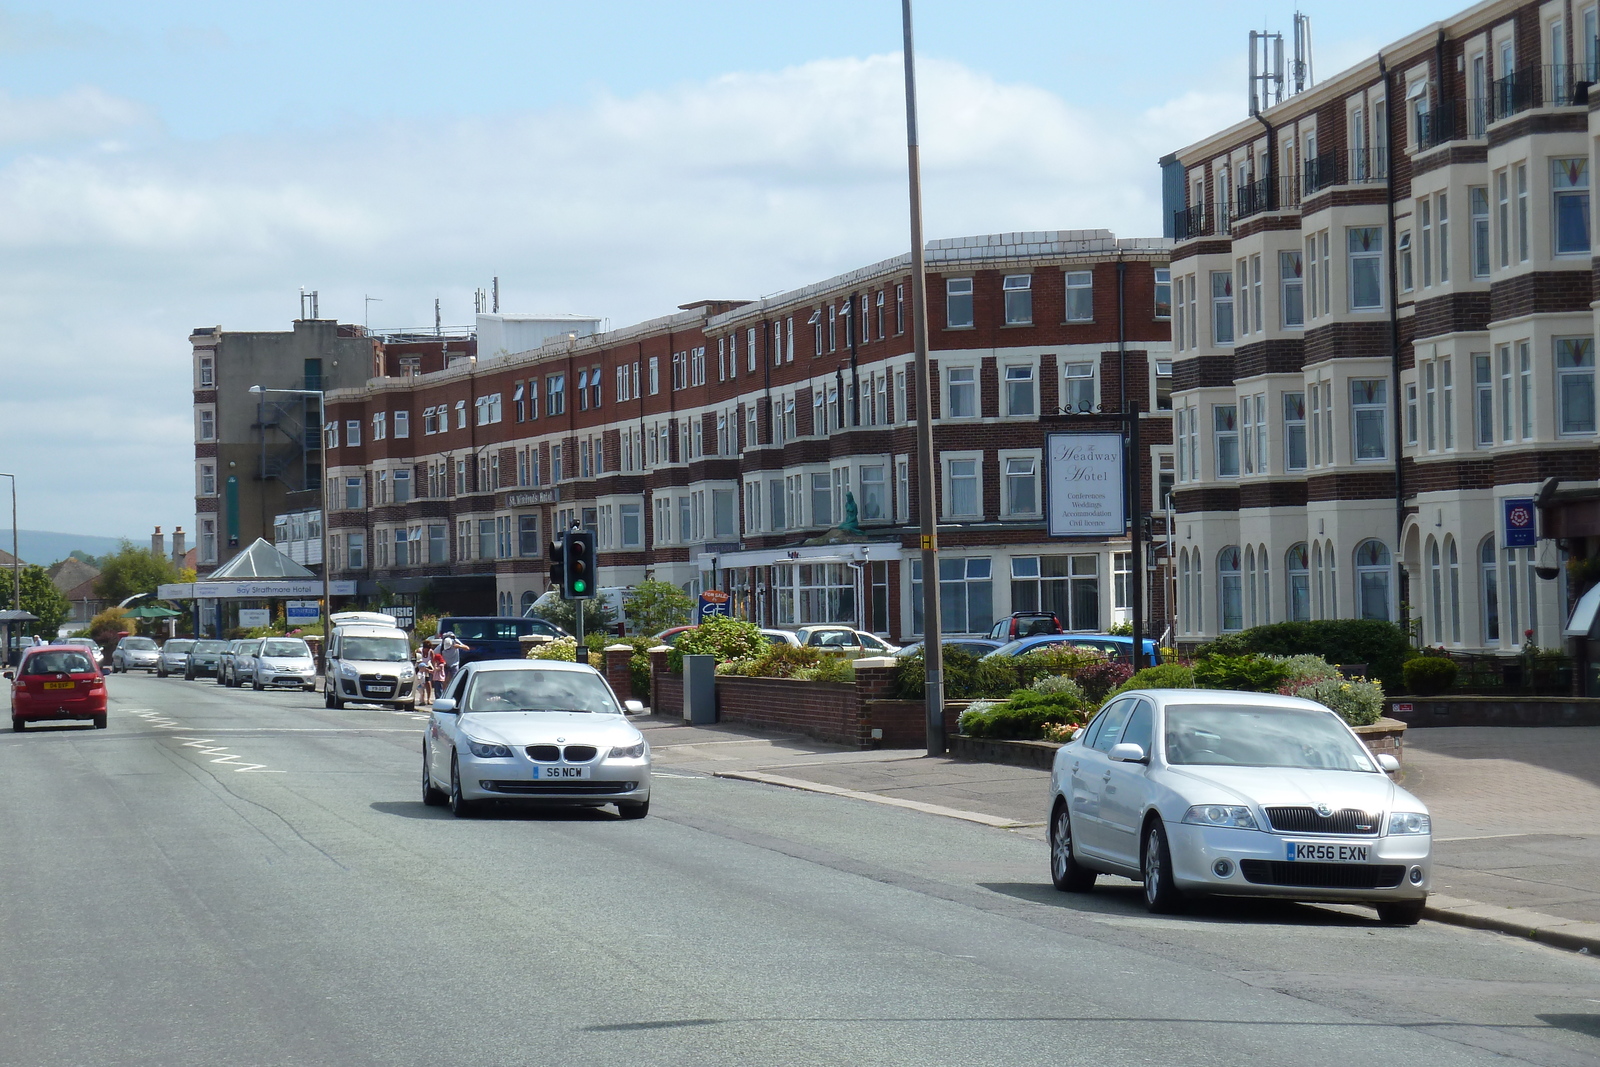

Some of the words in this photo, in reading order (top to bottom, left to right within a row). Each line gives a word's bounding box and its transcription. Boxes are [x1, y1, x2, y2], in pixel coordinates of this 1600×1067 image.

[1054, 444, 1117, 462] Headway
[1065, 465, 1107, 481] Hotel
[1072, 501, 1102, 509] Weddings
[1062, 510, 1112, 518] Accommodation
[1069, 519, 1083, 527] Civil
[1084, 519, 1106, 527] licence
[922, 535, 931, 549] H
[236, 586, 251, 594] Bay
[252, 585, 291, 593] Strathmore
[292, 585, 312, 593] Hotel
[382, 606, 413, 617] MUSIC
[397, 617, 413, 628] OP
[547, 768, 560, 777] S6
[562, 767, 582, 777] NCW
[1297, 845, 1334, 859] KR56
[1339, 846, 1367, 860] EXN
